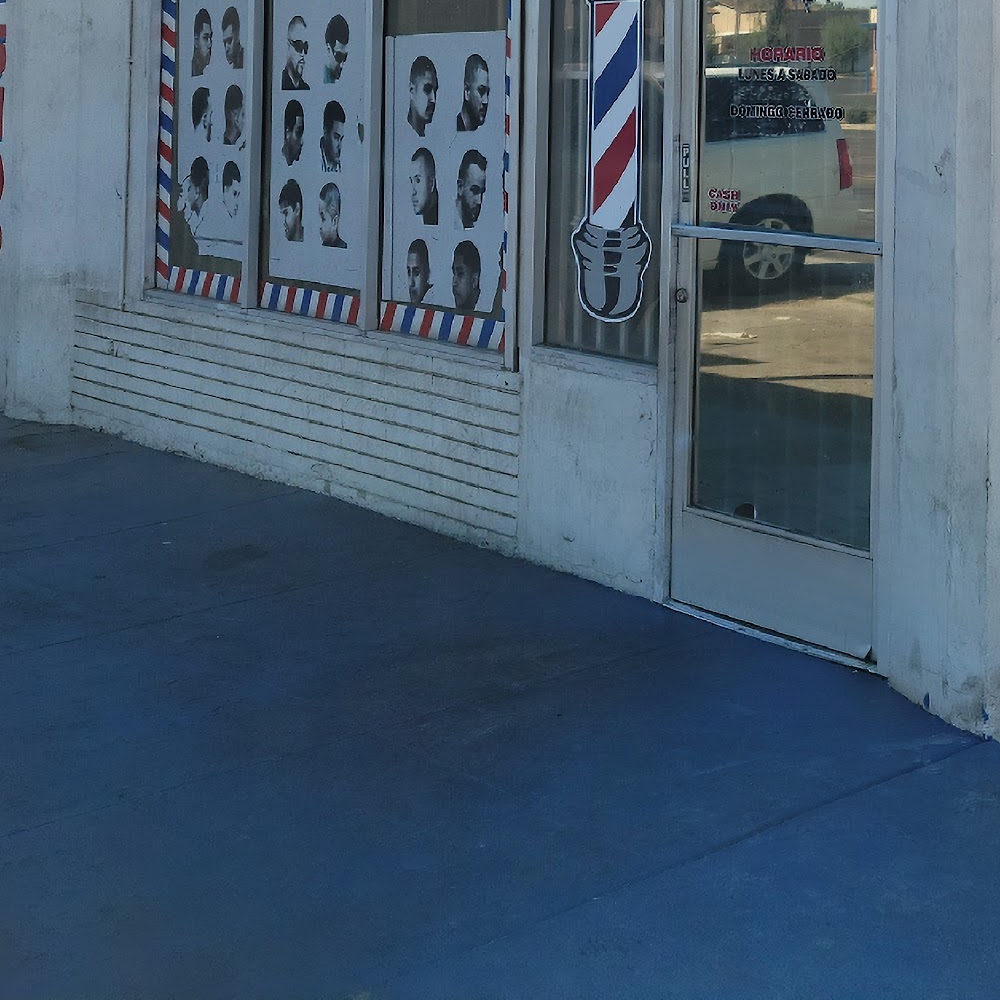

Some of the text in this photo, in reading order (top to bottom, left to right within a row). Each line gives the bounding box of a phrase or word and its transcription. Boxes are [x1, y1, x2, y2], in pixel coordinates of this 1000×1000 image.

[750, 46, 825, 62] HORARIO
[738, 68, 775, 81] LUNES
[788, 68, 837, 81] SABADO
[730, 103, 845, 121] DOMINGO CERRADO
[682, 147, 690, 189] PULL
[708, 188, 740, 201] CASH
